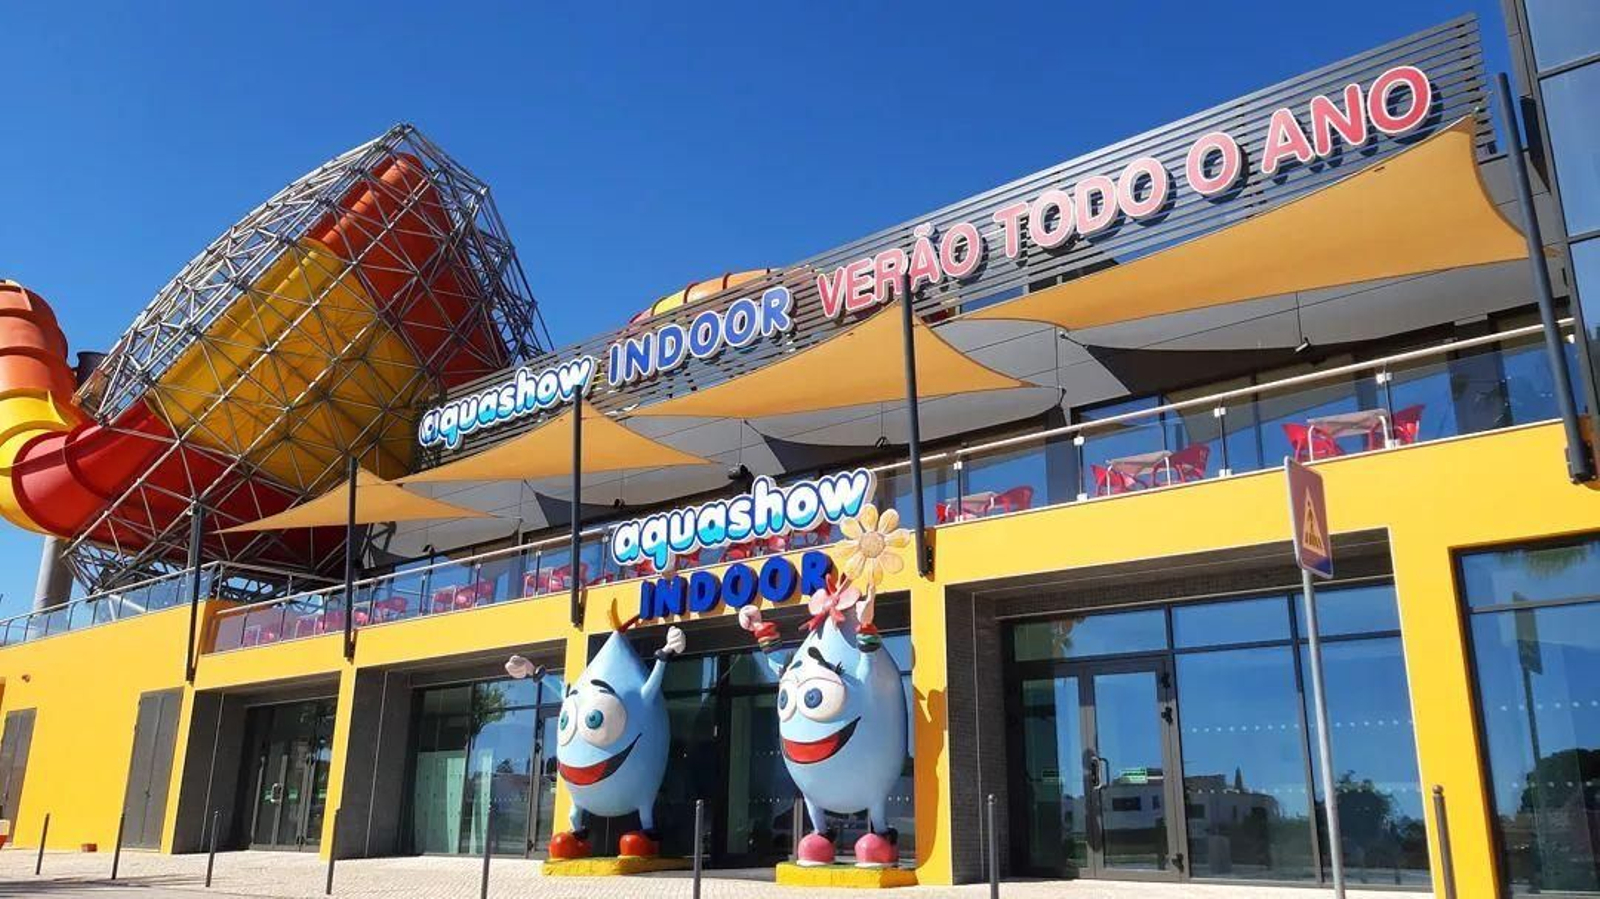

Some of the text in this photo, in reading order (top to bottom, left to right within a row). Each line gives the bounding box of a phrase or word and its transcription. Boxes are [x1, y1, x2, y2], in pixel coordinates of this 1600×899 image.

[418, 65, 1432, 449] aquashow INDOOR VERÃO TODO O ANO
[611, 467, 874, 572] aquashow
[639, 549, 832, 621] INDOOR
